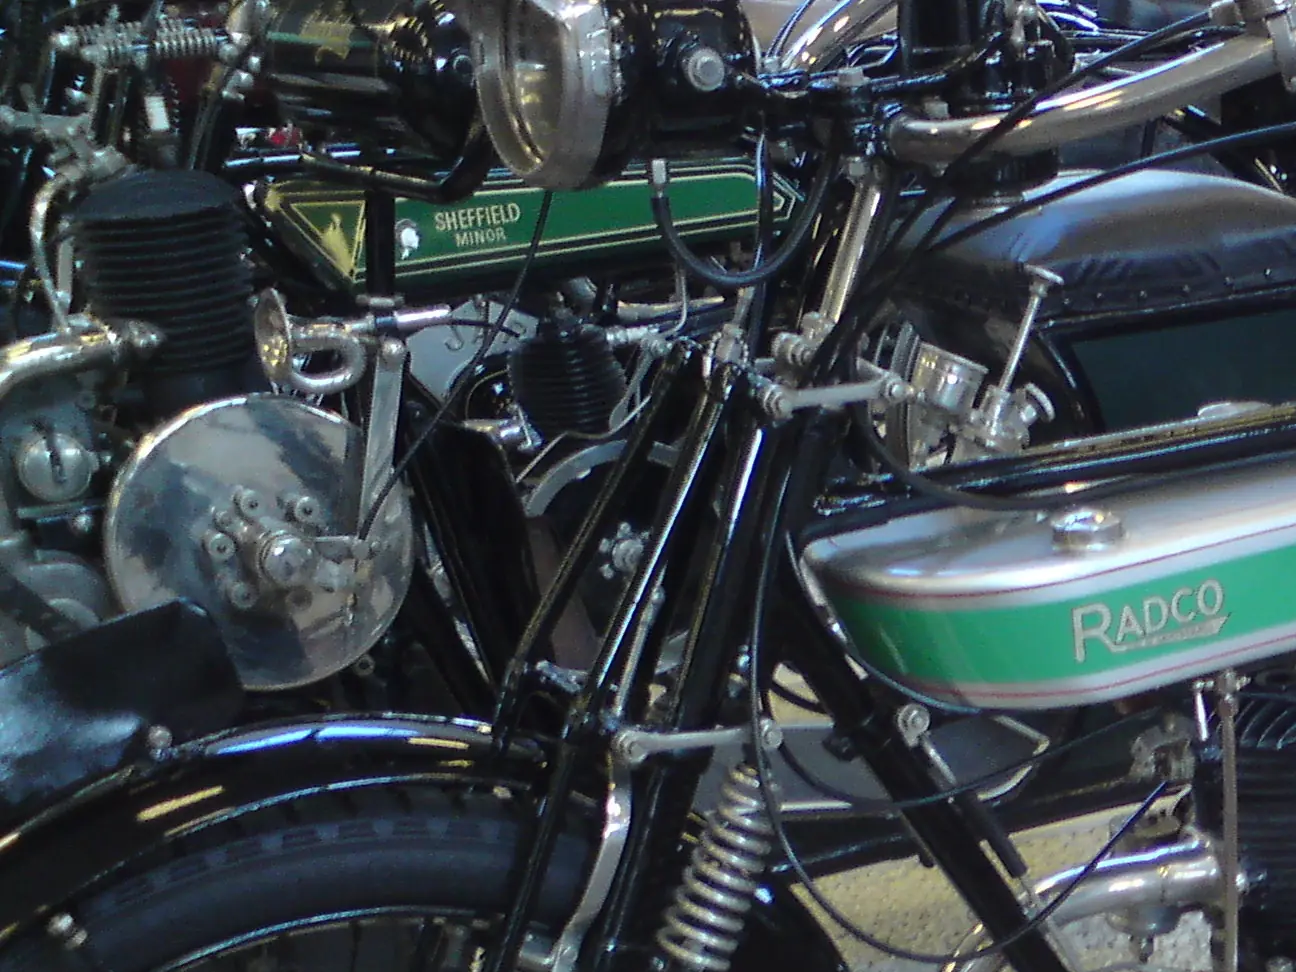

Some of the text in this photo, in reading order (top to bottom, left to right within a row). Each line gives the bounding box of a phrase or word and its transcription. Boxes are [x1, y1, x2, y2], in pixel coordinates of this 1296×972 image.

[434, 203, 520, 231] SHEFFIELD
[455, 227, 507, 247] MINOR
[1072, 579, 1224, 663] RADCO
